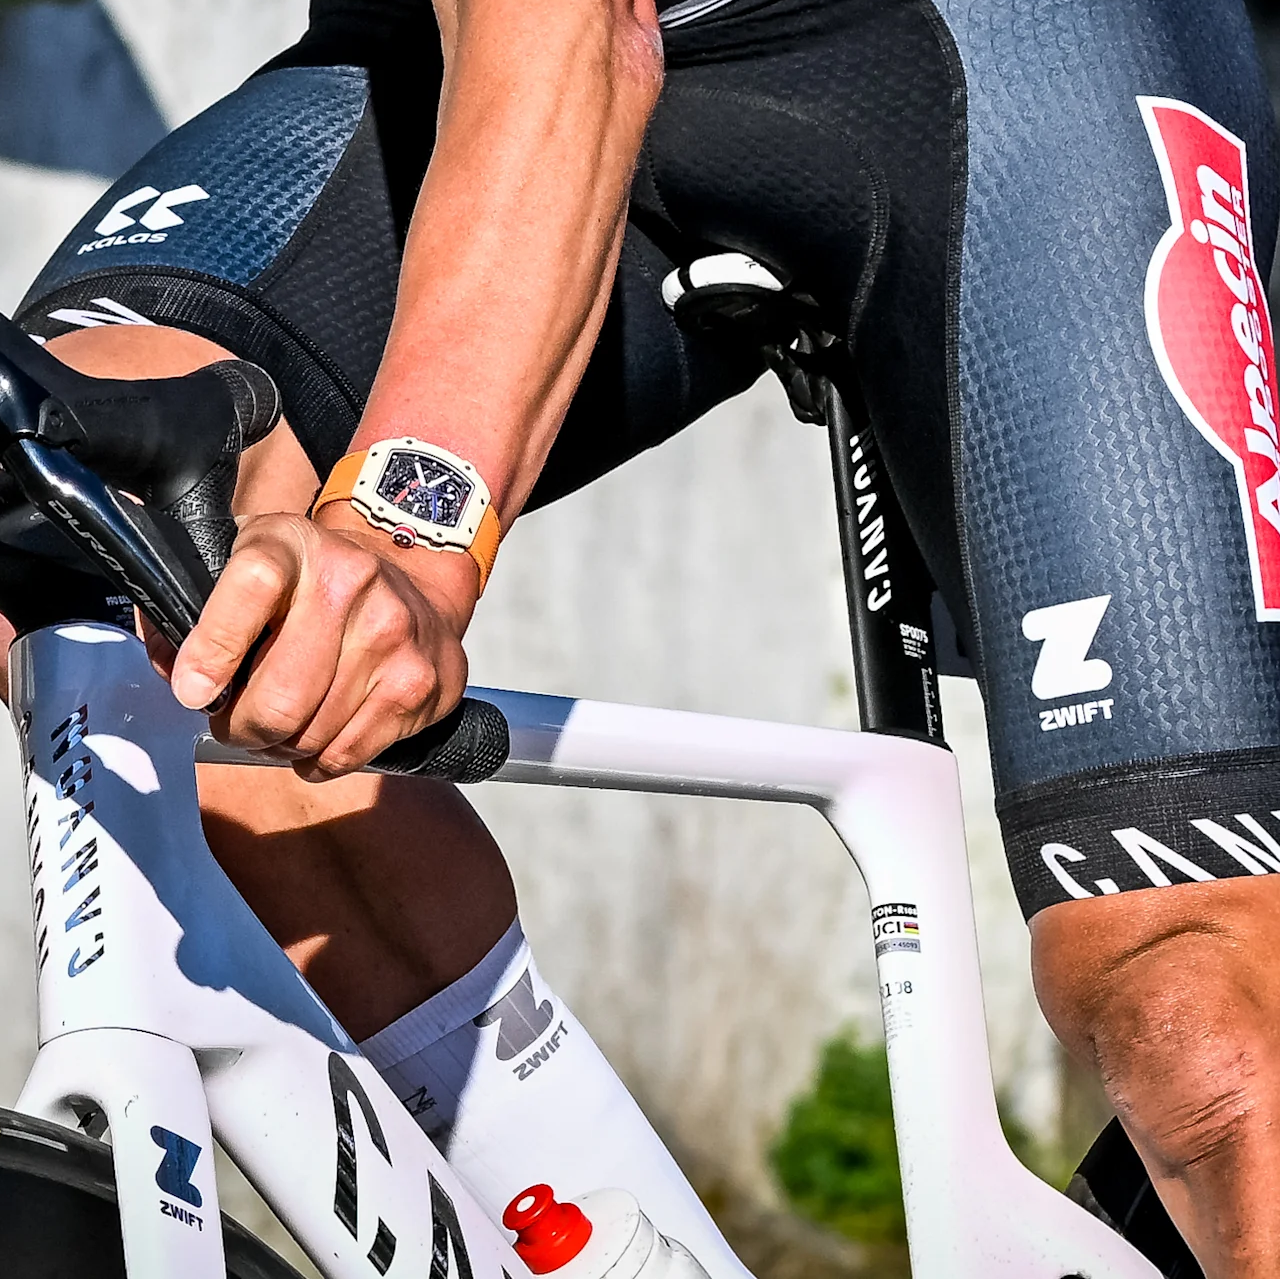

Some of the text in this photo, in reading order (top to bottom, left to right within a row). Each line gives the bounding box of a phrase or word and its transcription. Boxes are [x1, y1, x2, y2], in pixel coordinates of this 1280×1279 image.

[1039, 698, 1115, 732] ZWIFT
[50, 703, 106, 978] CANYON
[512, 1021, 572, 1082] ZWIFT
[159, 1199, 204, 1233] ZWIFT
